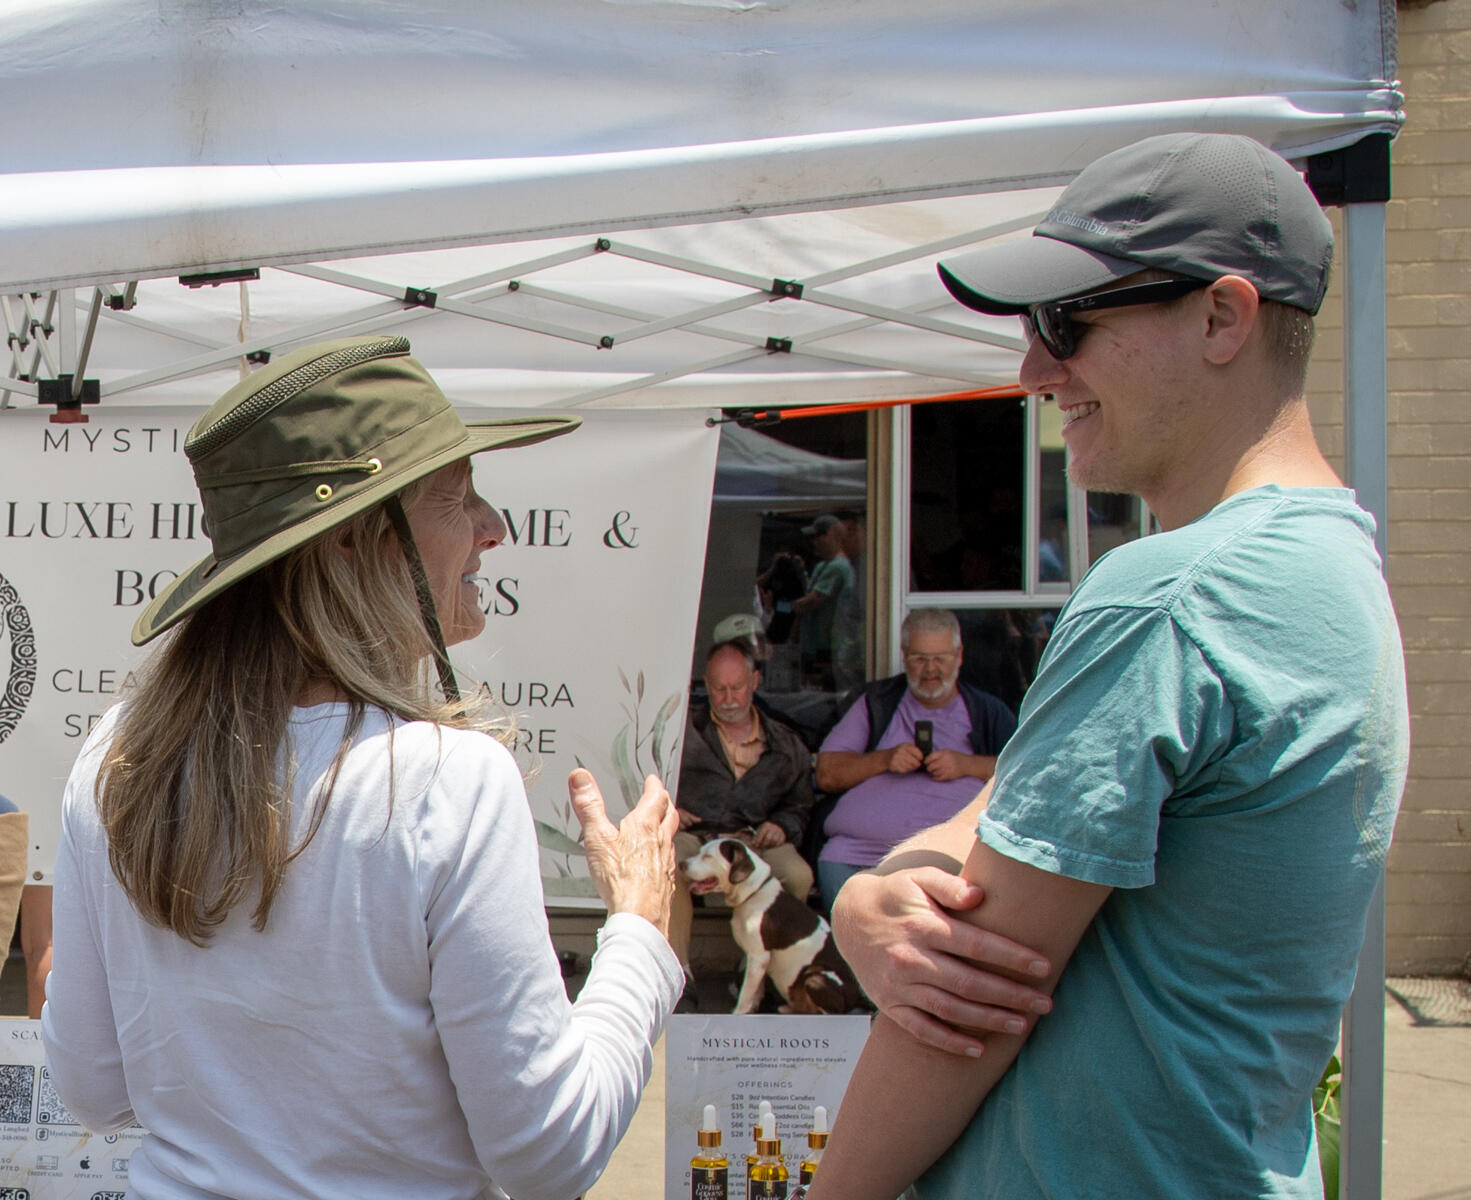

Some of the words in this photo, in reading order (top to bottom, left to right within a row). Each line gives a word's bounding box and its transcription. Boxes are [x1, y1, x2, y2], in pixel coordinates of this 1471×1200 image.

[1056, 210, 1109, 236] Columbia
[43, 428, 178, 453] MYSTI
[5, 502, 135, 540] LUXE
[603, 510, 640, 549] &
[476, 681, 575, 708] AURA
[702, 1038, 773, 1048] MYSTICAL
[780, 1038, 830, 1048] ROOTS
